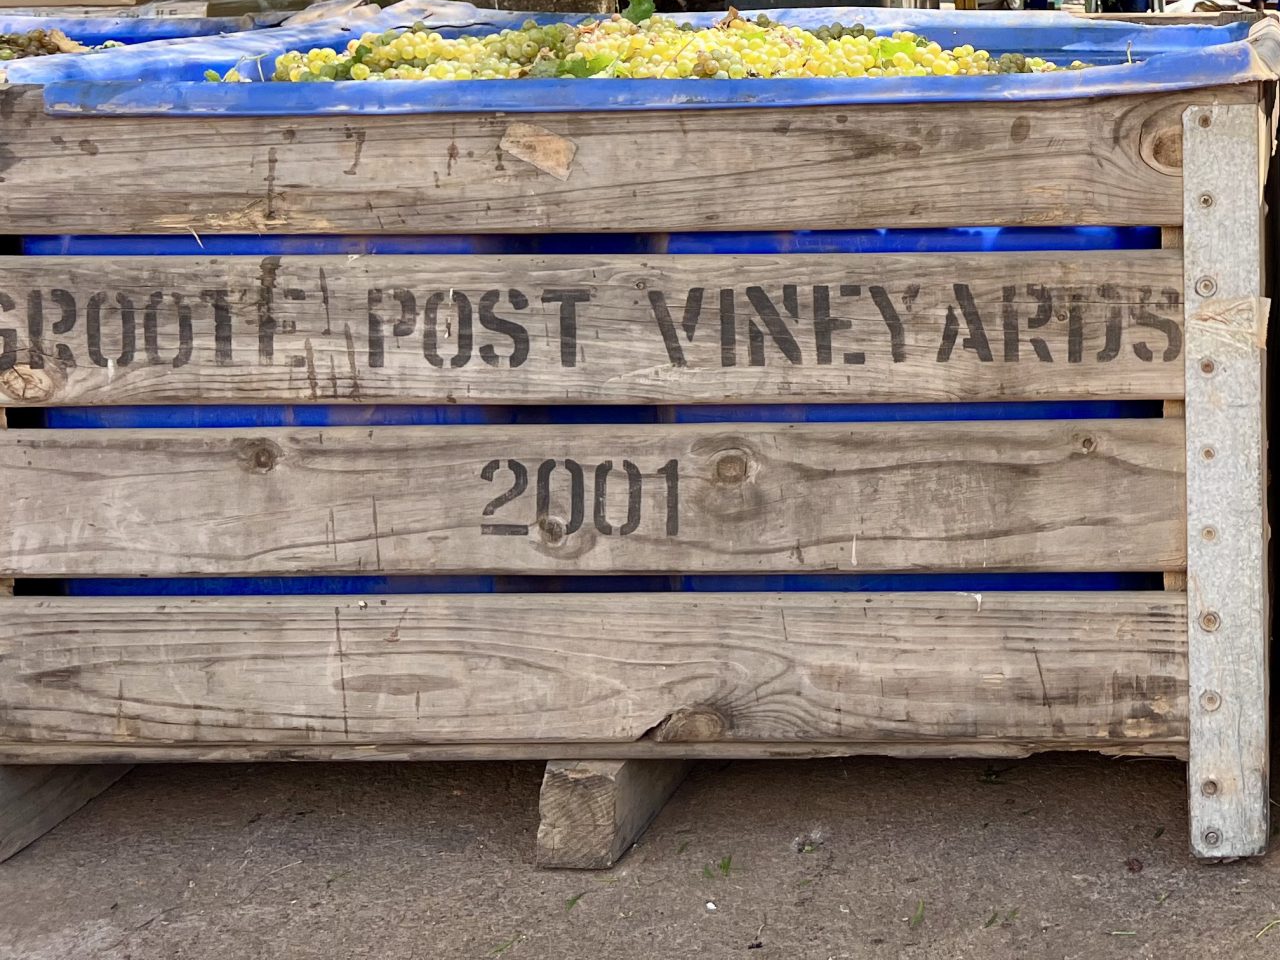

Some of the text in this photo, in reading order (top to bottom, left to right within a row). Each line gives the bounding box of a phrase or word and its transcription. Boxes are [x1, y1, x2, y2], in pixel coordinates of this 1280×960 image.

[367, 287, 592, 370] POST
[647, 283, 1182, 368] VINEYARDS
[479, 458, 680, 537] 2001
